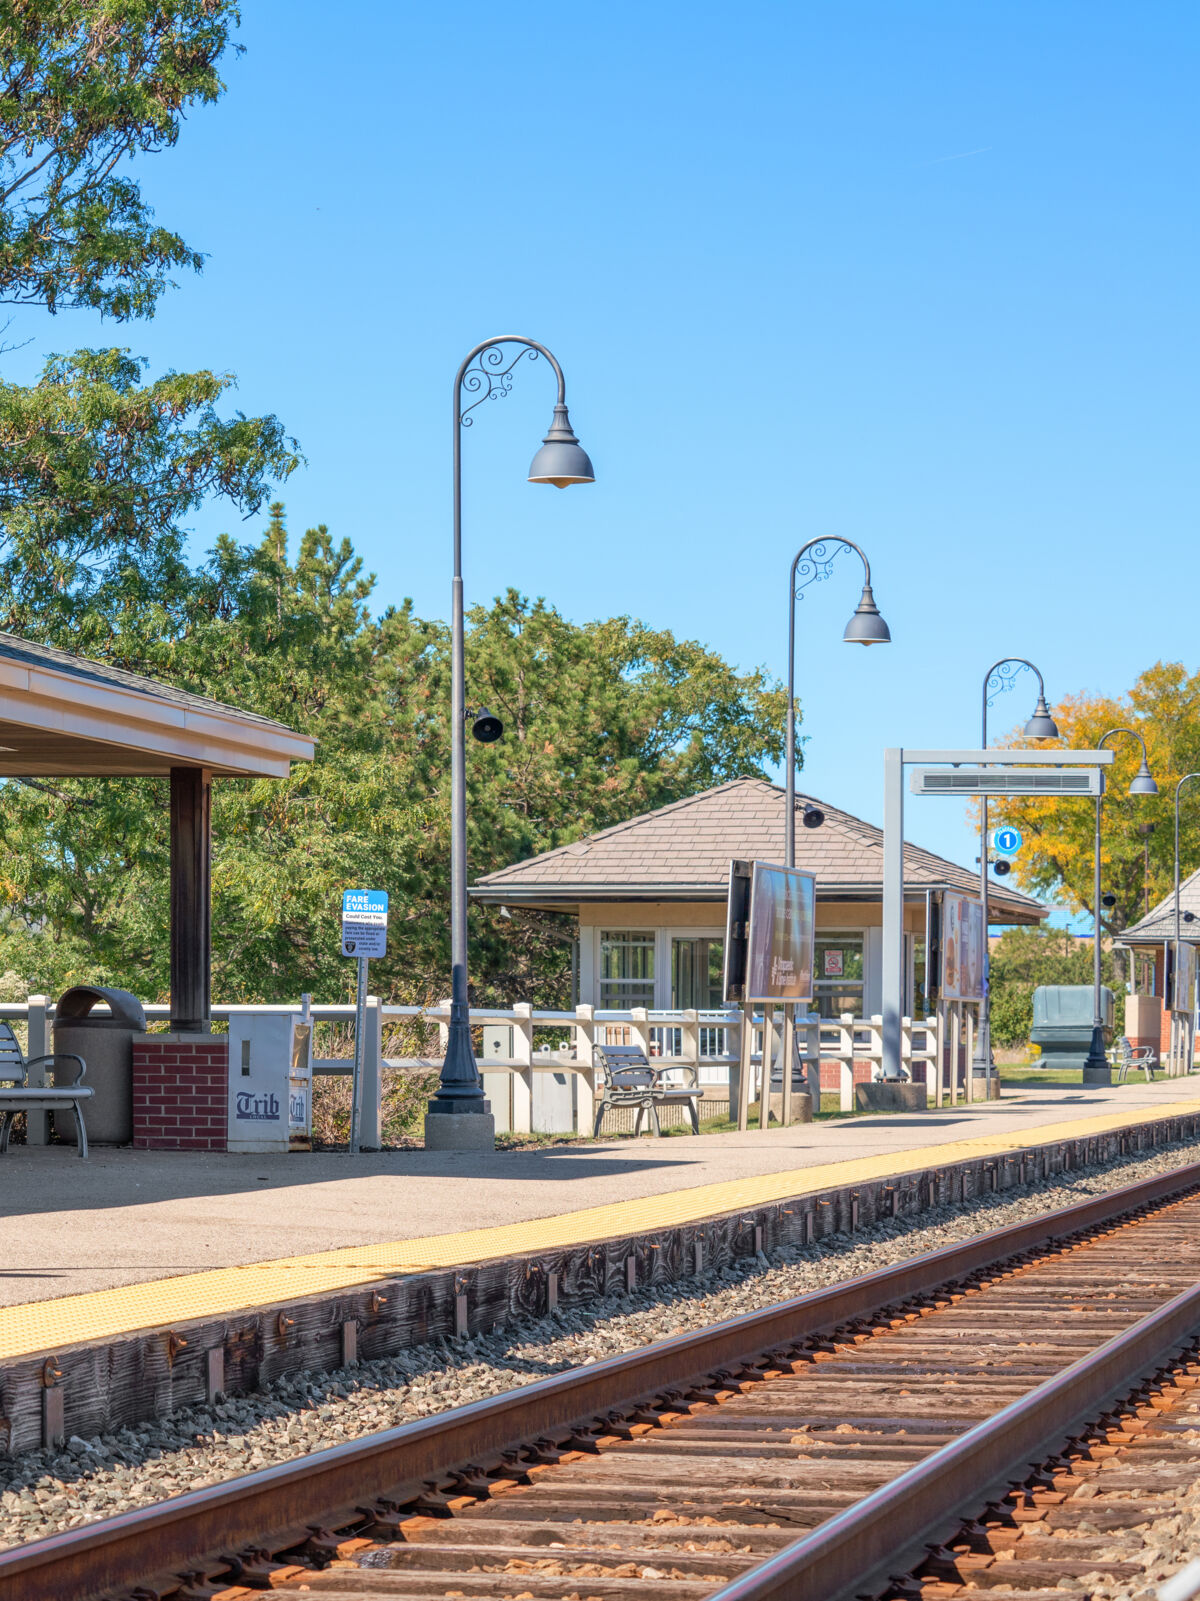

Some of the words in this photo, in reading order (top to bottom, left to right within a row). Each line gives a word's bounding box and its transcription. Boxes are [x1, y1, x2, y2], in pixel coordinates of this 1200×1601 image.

[1004, 834, 1010, 848] 1
[346, 903, 384, 911] EVASION
[236, 1092, 279, 1115] Trib
[290, 1094, 304, 1117] Trib
